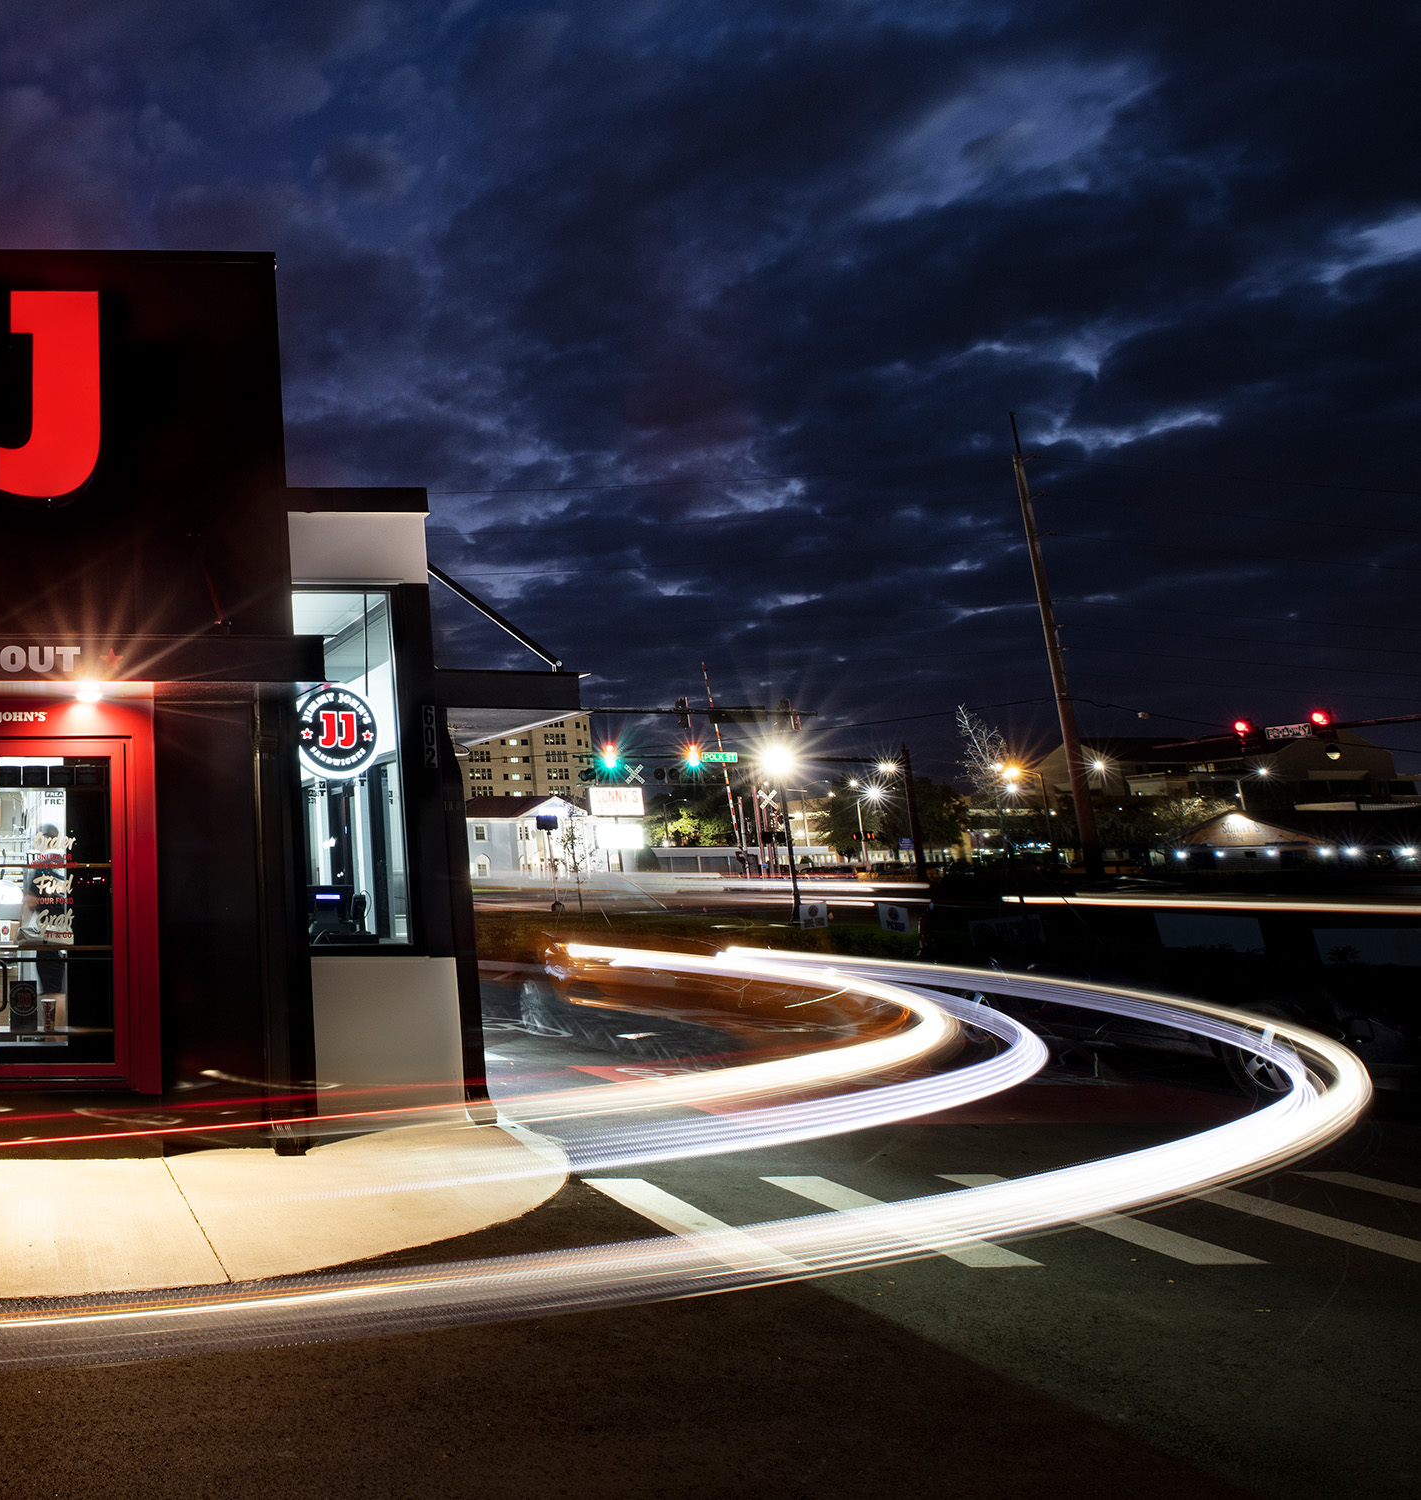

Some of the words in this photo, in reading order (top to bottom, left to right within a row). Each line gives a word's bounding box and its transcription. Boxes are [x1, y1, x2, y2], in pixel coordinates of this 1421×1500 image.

[0, 645, 81, 672] OUT
[302, 692, 335, 723] JIMMY
[338, 692, 372, 724] JOHN'S
[319, 710, 357, 749] JJ
[424, 706, 436, 768] 602
[1267, 724, 1311, 739] BROADWAY
[309, 746, 367, 767] SANDWICHES
[704, 753, 724, 761] POLK
[725, 753, 736, 761] ST
[594, 789, 639, 803] SONNY'S
[33, 831, 76, 850] Order
[63, 853, 72, 861] OR
[33, 873, 74, 895] Find
[36, 908, 75, 936] Grab
